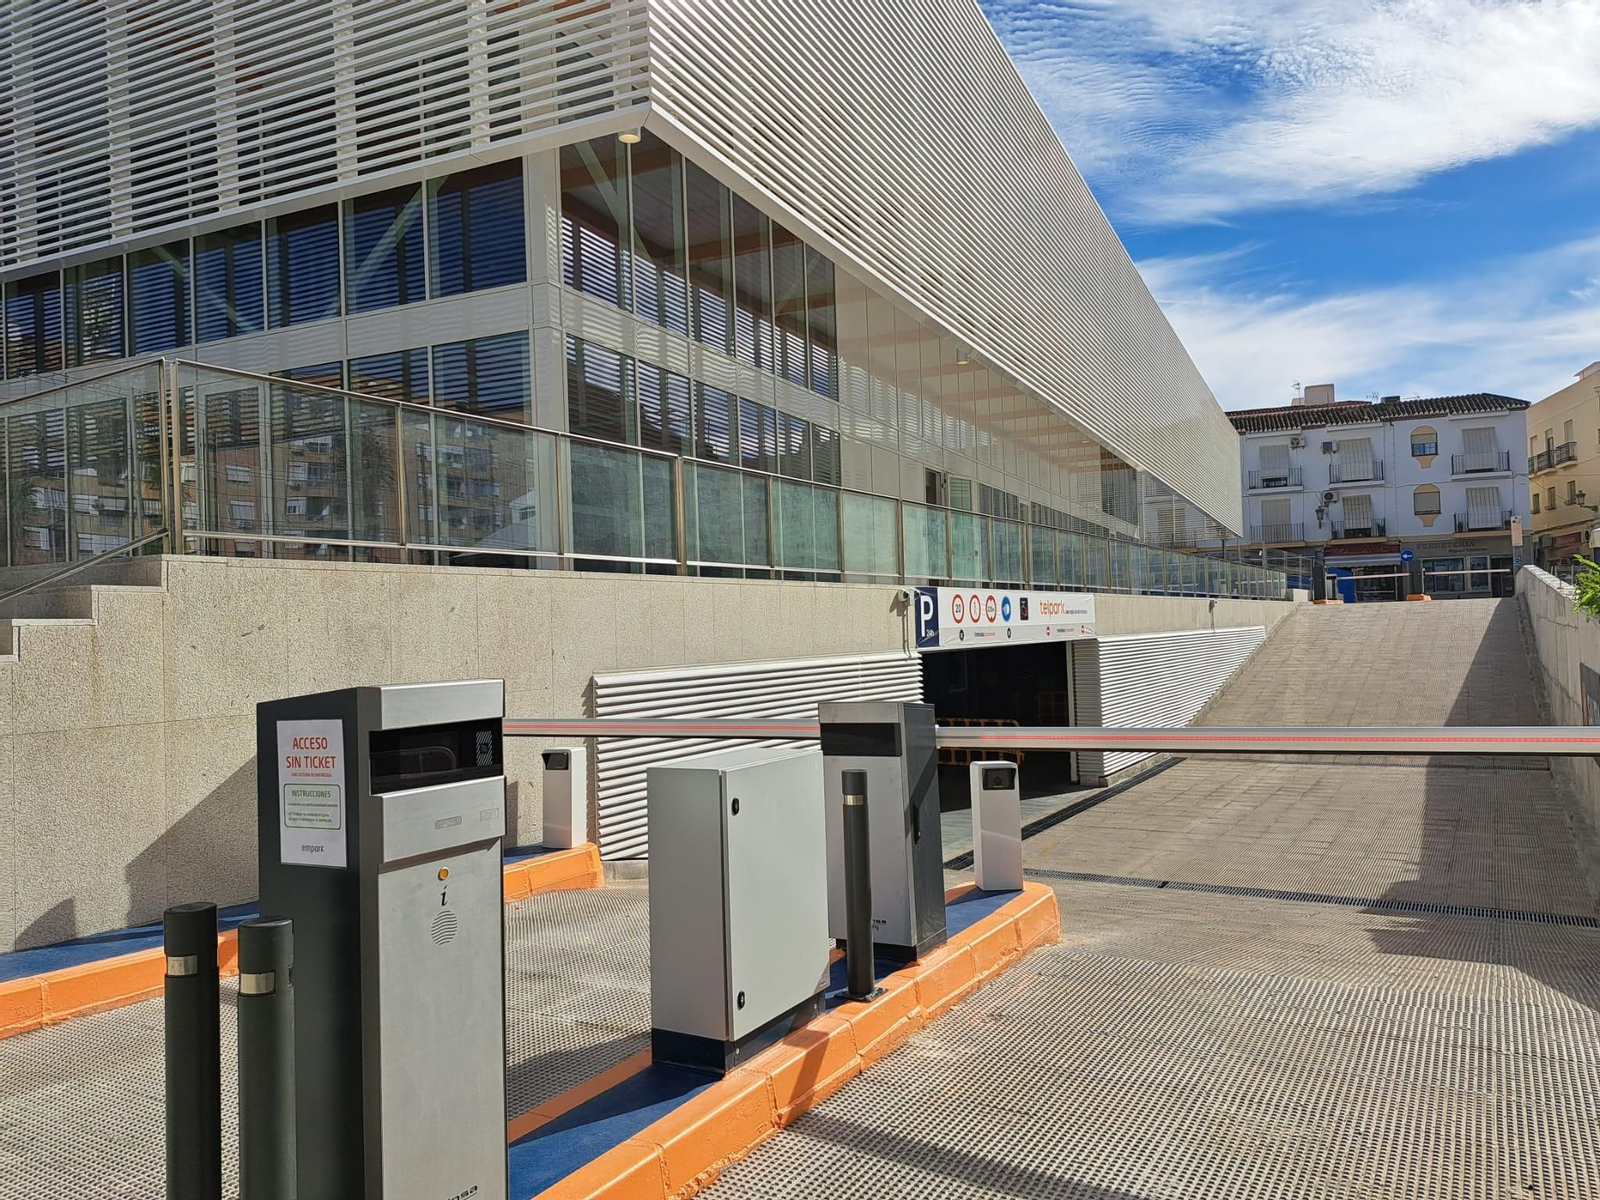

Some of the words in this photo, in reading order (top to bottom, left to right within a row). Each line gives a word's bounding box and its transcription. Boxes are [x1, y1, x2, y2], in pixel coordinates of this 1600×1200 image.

[955, 604, 961, 613] 20
[1040, 600, 1065, 618] telpark
[920, 595, 934, 637] P
[293, 737, 328, 750] ACCESO
[286, 756, 301, 769] SIN
[304, 756, 336, 769] TICKET
[292, 789, 331, 798] INSTRUCCIONES
[302, 845, 324, 854] empark
